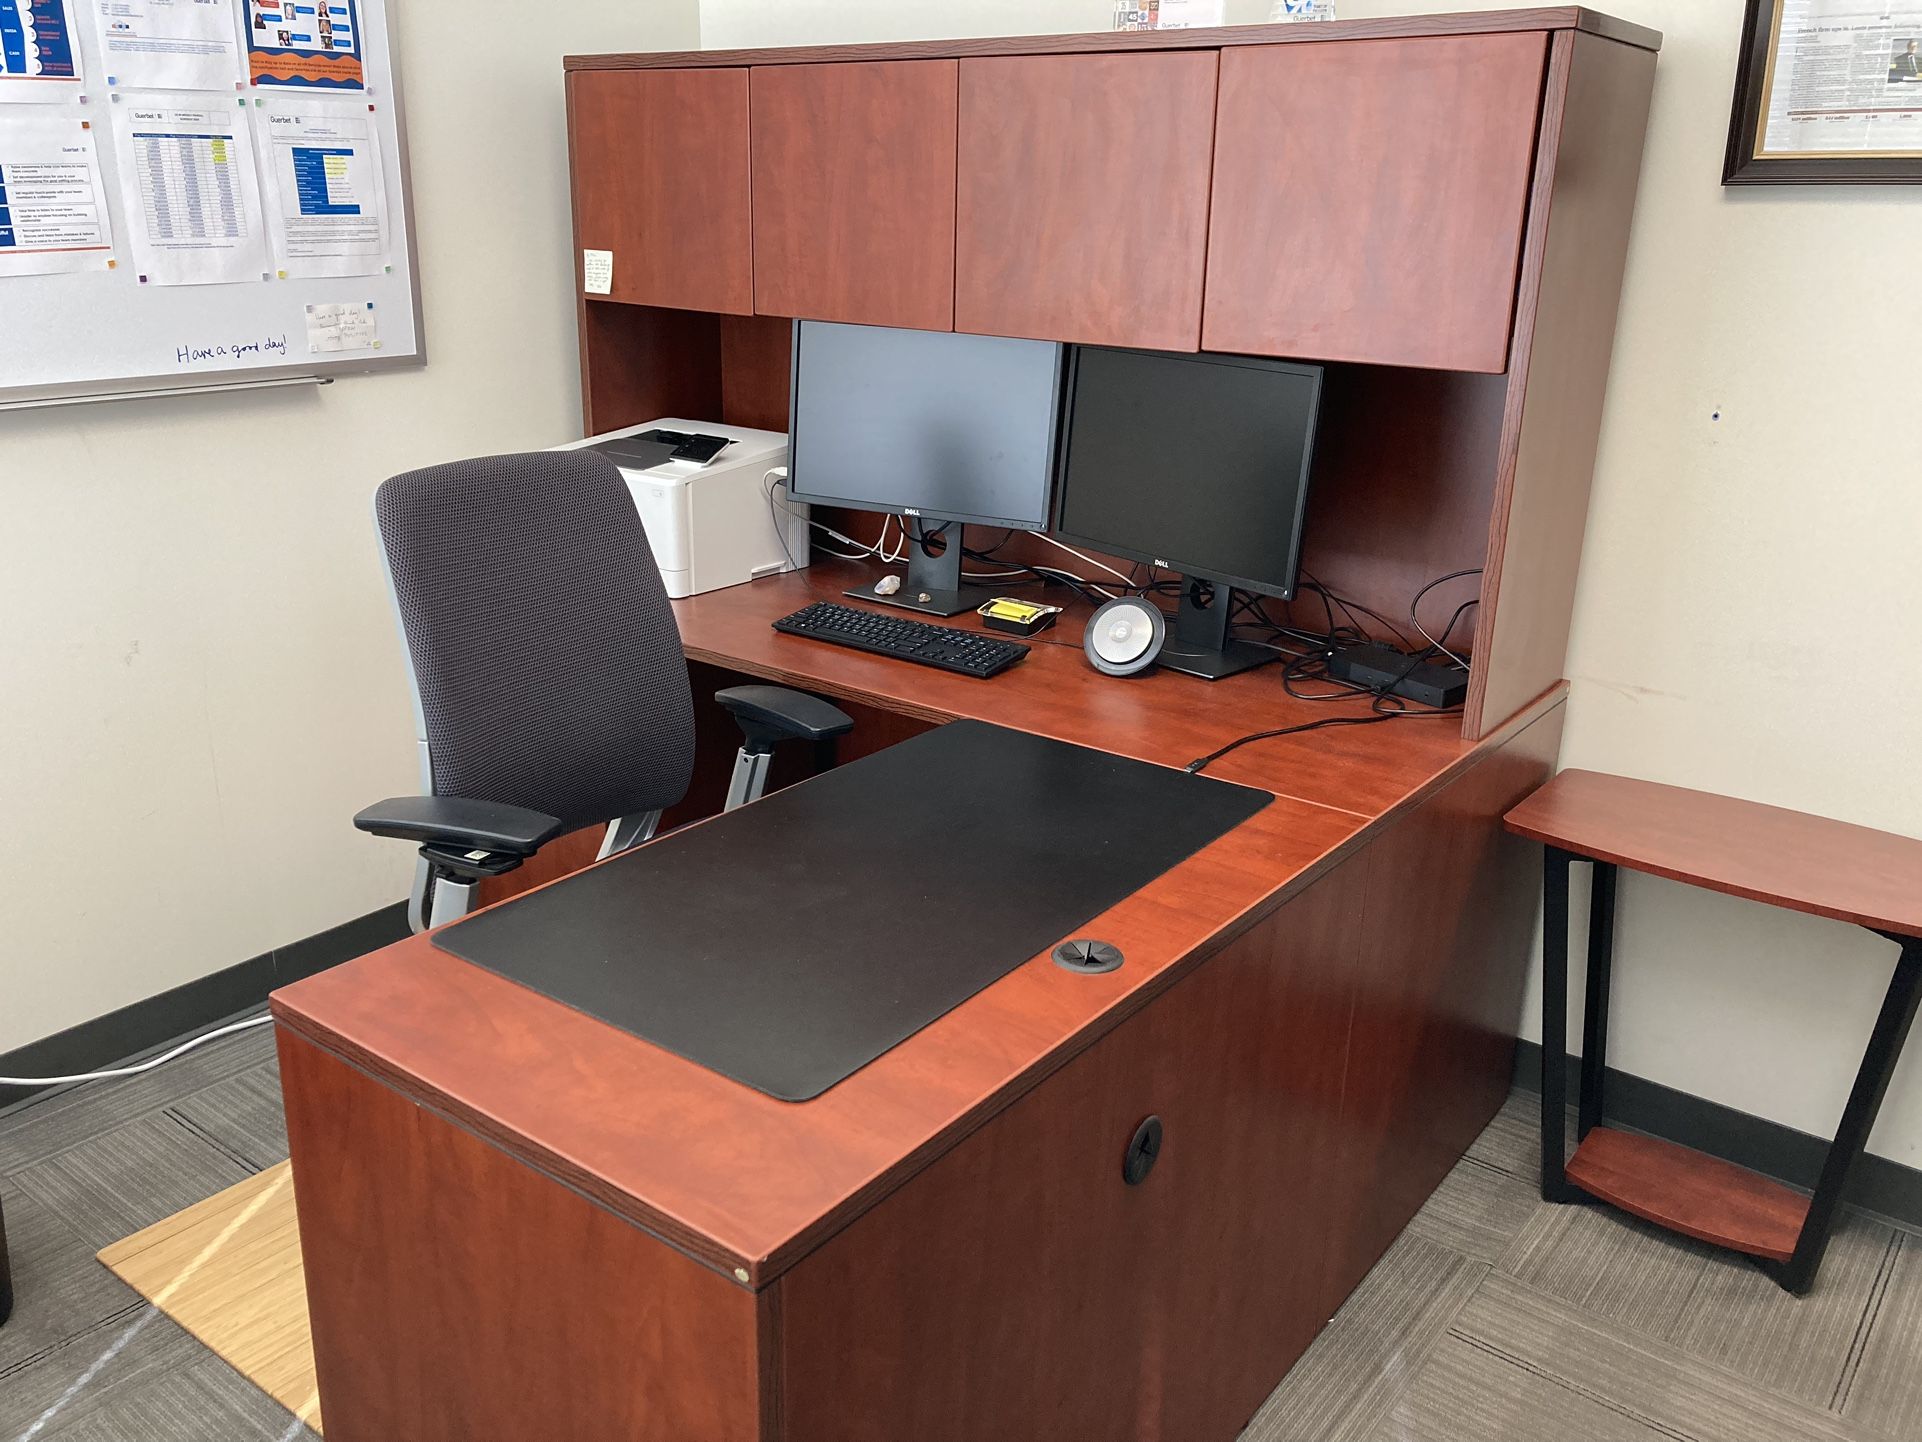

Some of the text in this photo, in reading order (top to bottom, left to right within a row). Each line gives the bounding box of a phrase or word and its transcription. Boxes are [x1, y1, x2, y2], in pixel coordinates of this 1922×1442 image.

[176, 333, 287, 363] Have a good day!
[1154, 559, 1169, 568] DELL
